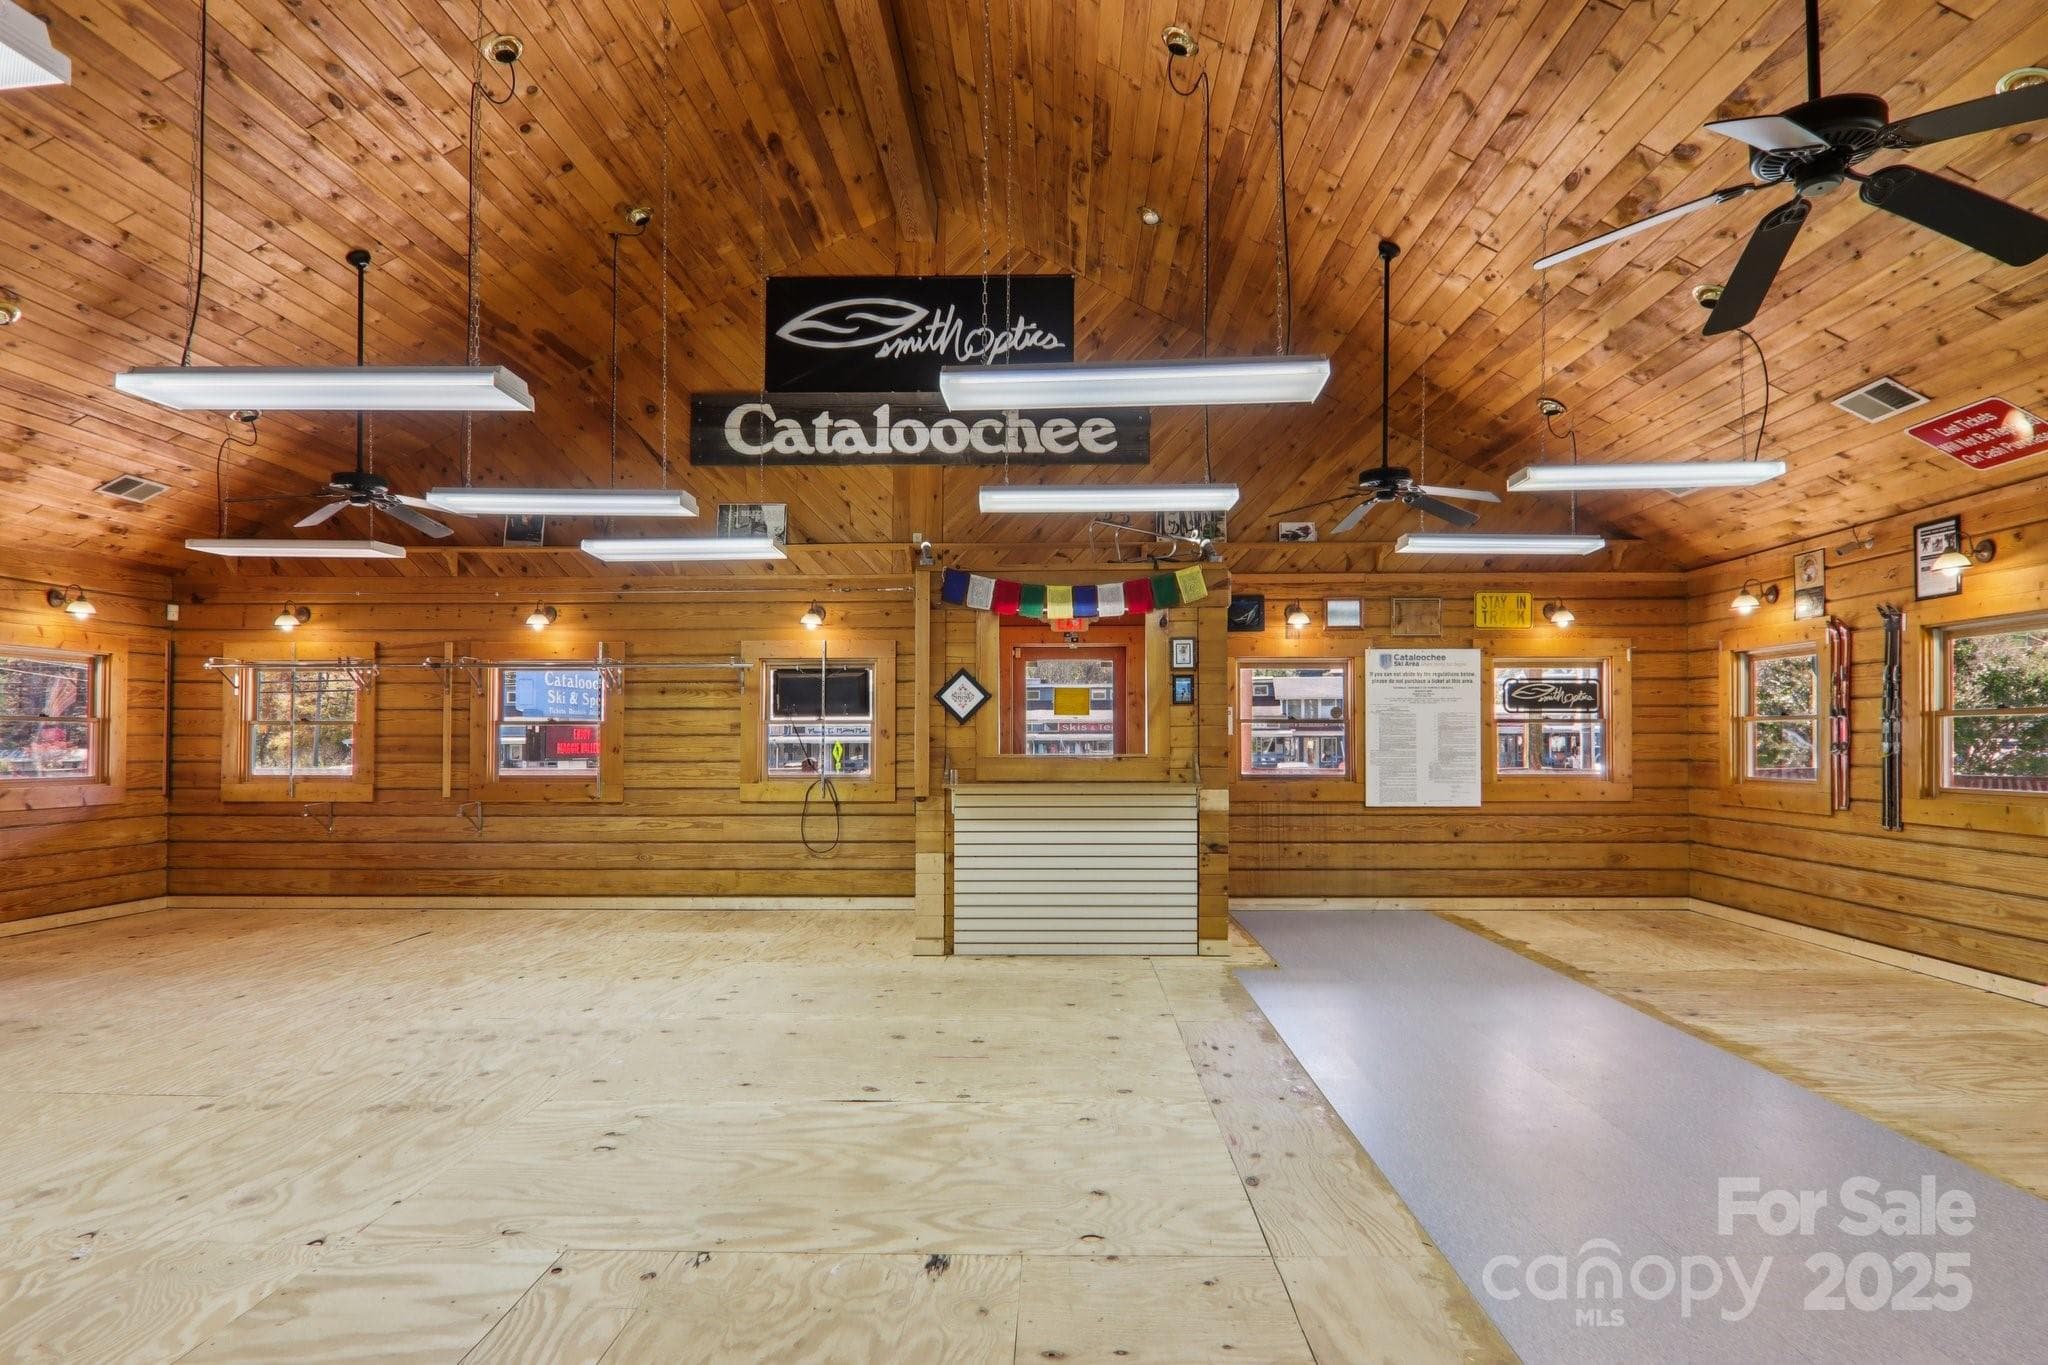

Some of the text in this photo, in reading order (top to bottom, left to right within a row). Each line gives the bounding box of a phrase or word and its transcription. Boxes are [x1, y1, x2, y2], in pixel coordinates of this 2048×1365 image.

[724, 403, 1118, 455] Cataloochee
[1933, 412, 1998, 437] Lost Tickets
[1954, 436, 1983, 448] Not
[1971, 433, 1996, 442] Be
[1961, 454, 1985, 463] On
[1976, 445, 2009, 459] Cash
[1481, 595, 1526, 609] STAY IN
[1393, 653, 1447, 661] Cataloochee
[547, 690, 597, 709] Ski & Sp
[1062, 723, 1088, 732] Skis
